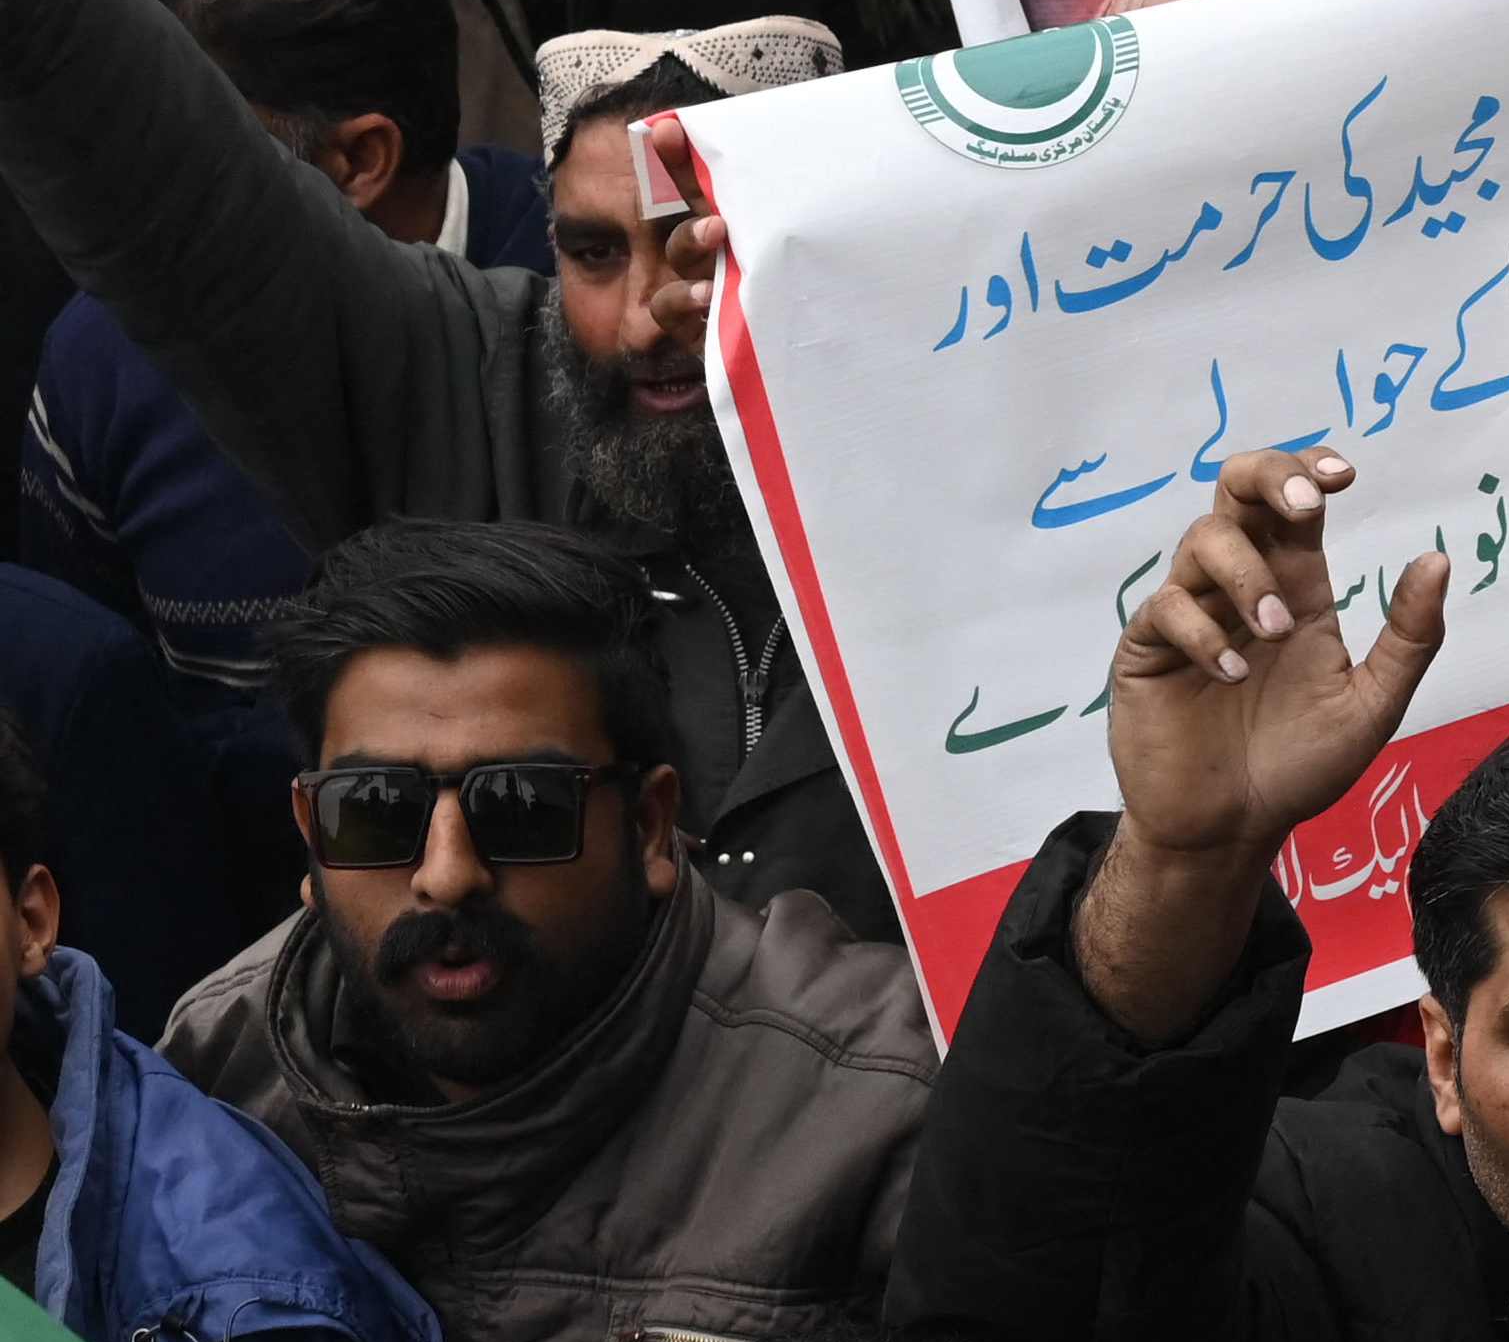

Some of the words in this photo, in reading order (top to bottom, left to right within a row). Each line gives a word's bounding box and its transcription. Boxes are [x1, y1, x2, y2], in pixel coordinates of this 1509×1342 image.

[1303, 74, 1388, 262] کی
[1382, 95, 1504, 241] مجید
[932, 231, 1040, 353] اور
[1052, 169, 1298, 315] حرمت
[1031, 451, 1178, 530] سے
[1309, 760, 1412, 901] لیگ
